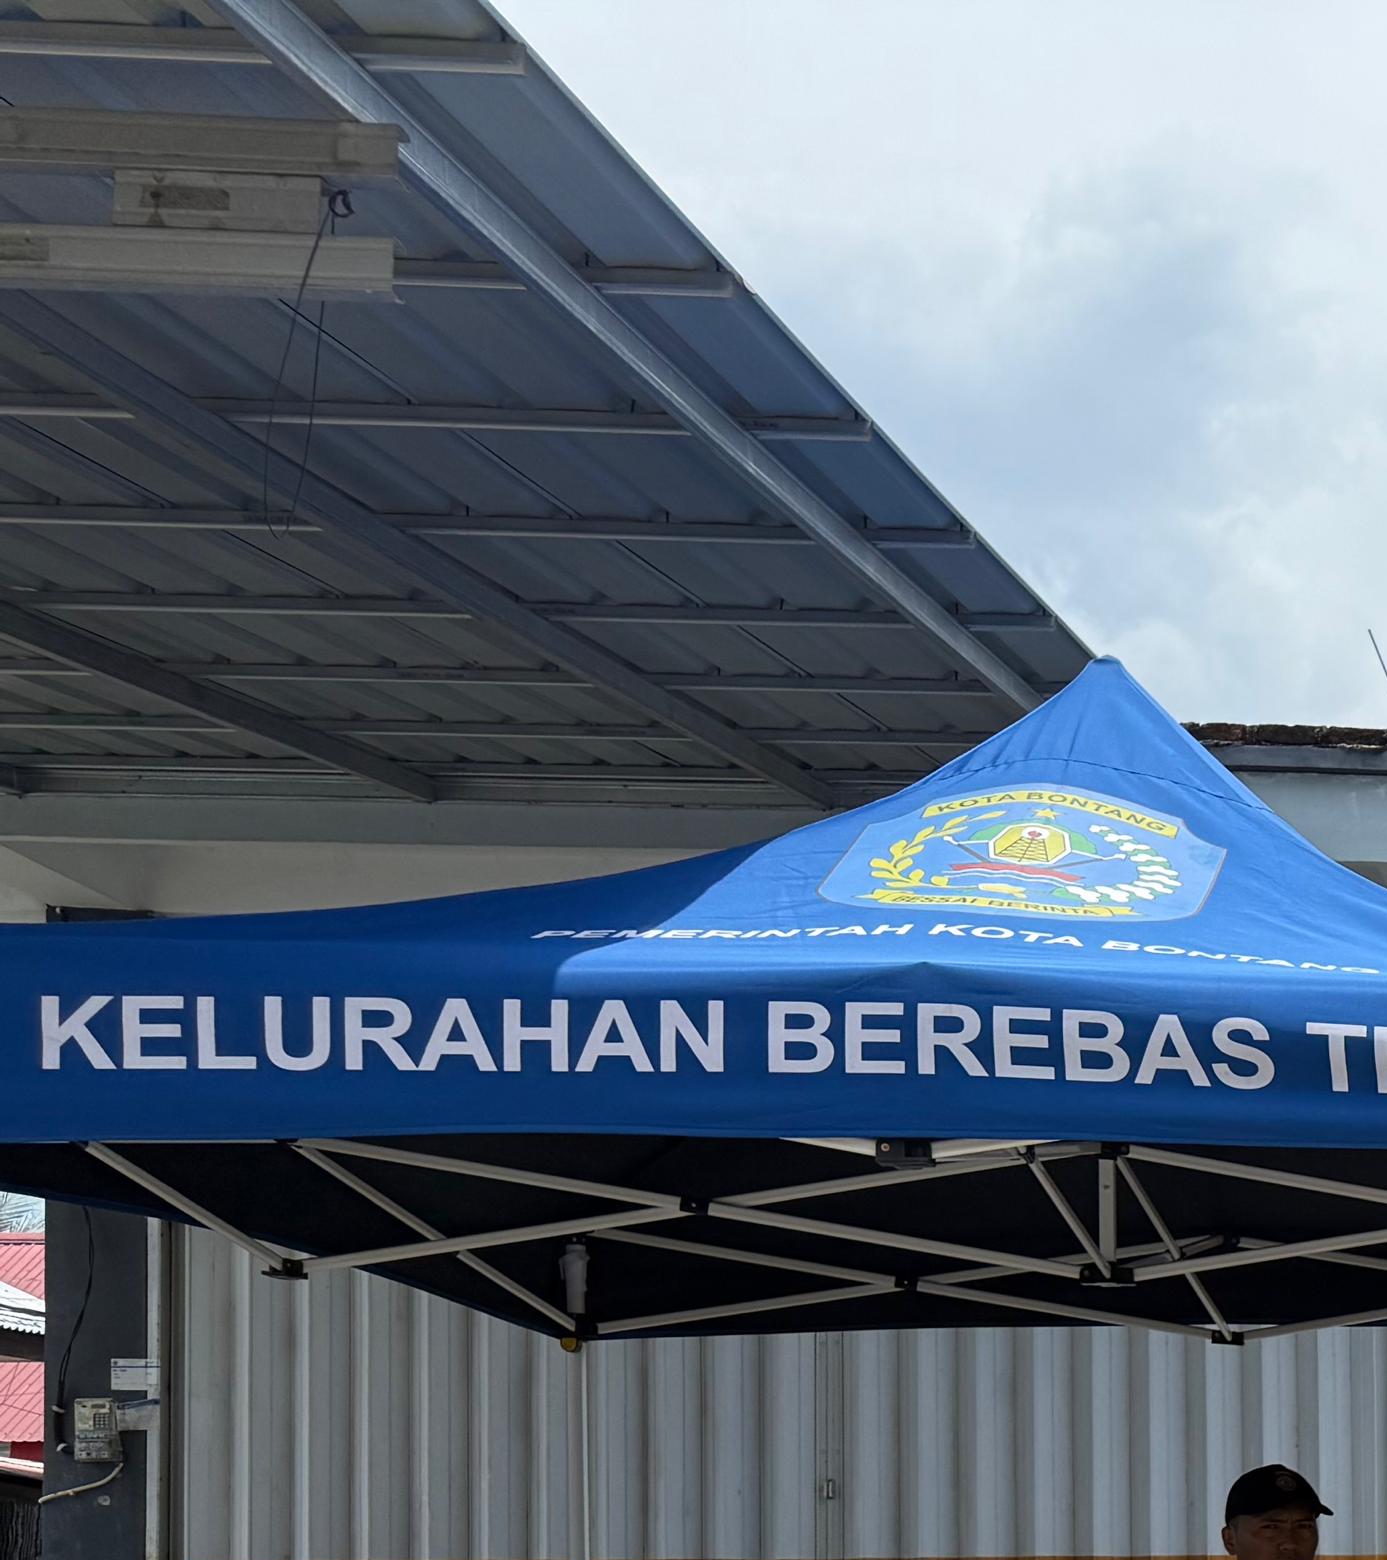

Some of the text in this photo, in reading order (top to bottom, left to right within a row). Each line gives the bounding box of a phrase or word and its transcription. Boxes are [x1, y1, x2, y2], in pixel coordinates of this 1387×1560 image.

[936, 791, 1168, 833] KOTA BONTANG
[529, 922, 1381, 975] PEMERINTAH KOTA BONTANG
[40, 995, 725, 1073] KELURAHAN
[767, 1000, 1276, 1090] BEREBAS
